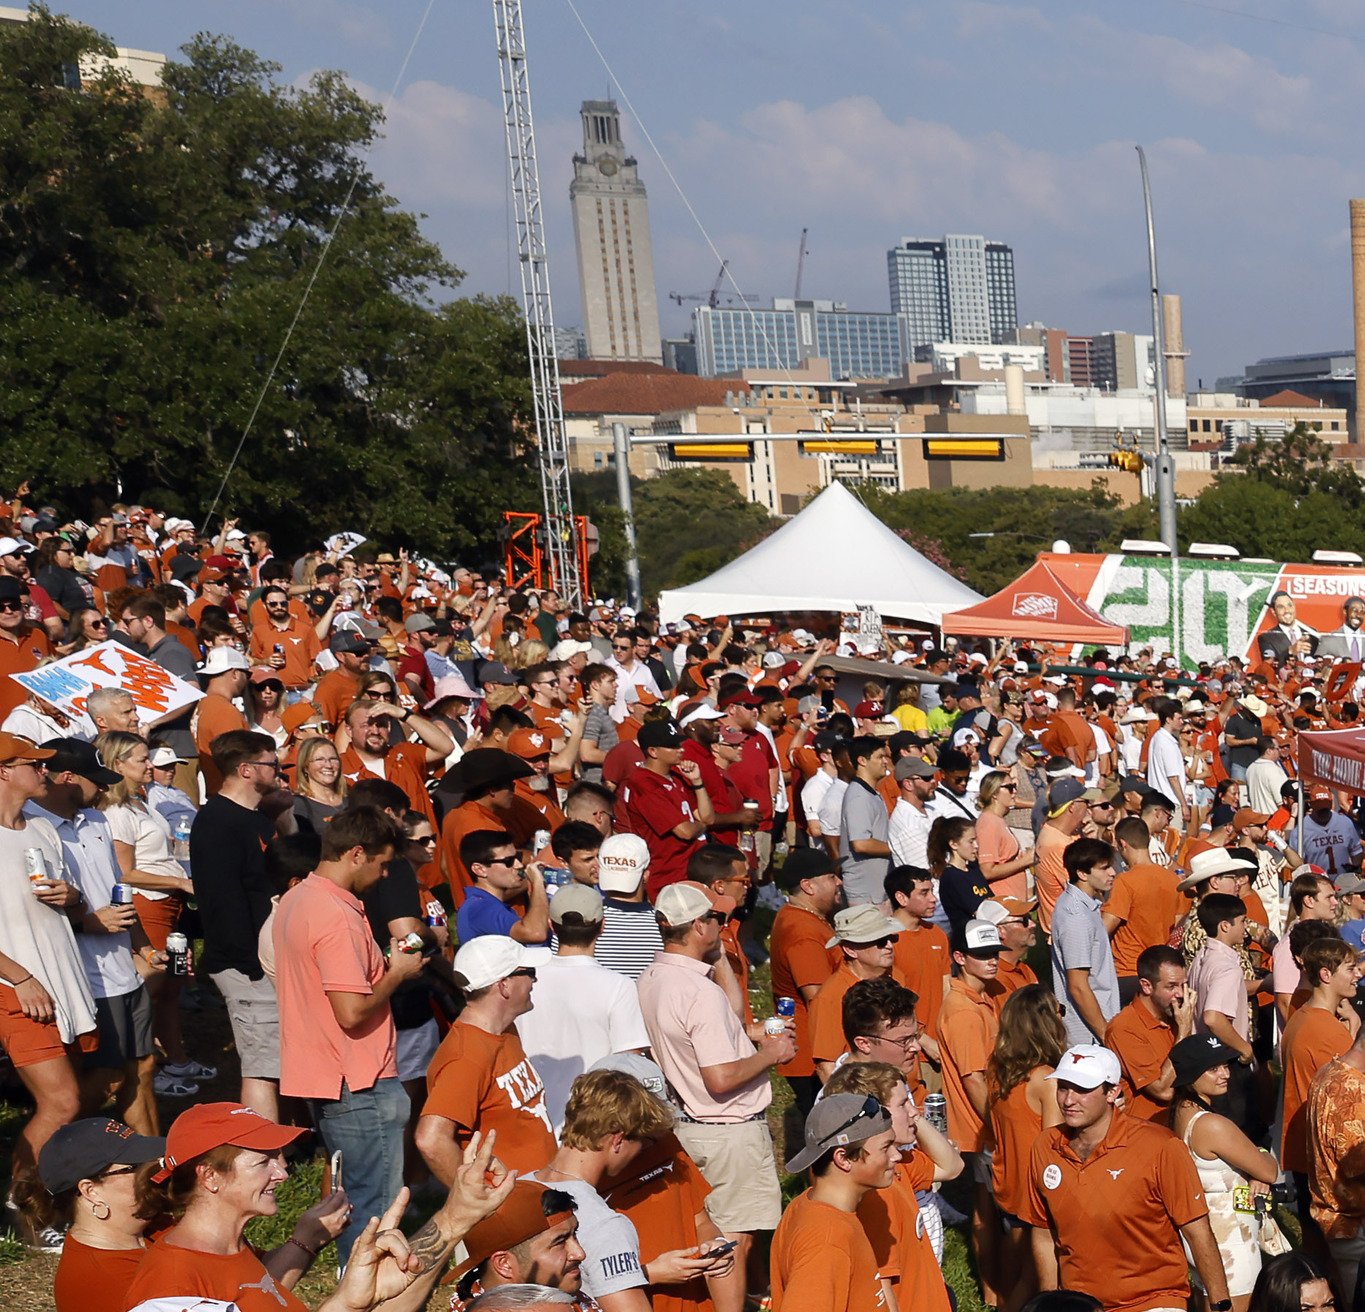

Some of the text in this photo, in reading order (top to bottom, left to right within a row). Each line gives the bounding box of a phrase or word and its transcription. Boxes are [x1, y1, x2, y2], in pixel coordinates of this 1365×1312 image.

[18, 664, 90, 701] BAMA
[1311, 748, 1331, 780] THE
[1333, 752, 1361, 787] HOME
[1312, 836, 1344, 848] TEXAS
[602, 856, 637, 868] TEXAS
[638, 1167, 664, 1182] TEXAS
[599, 1250, 640, 1279] TYLER'S
